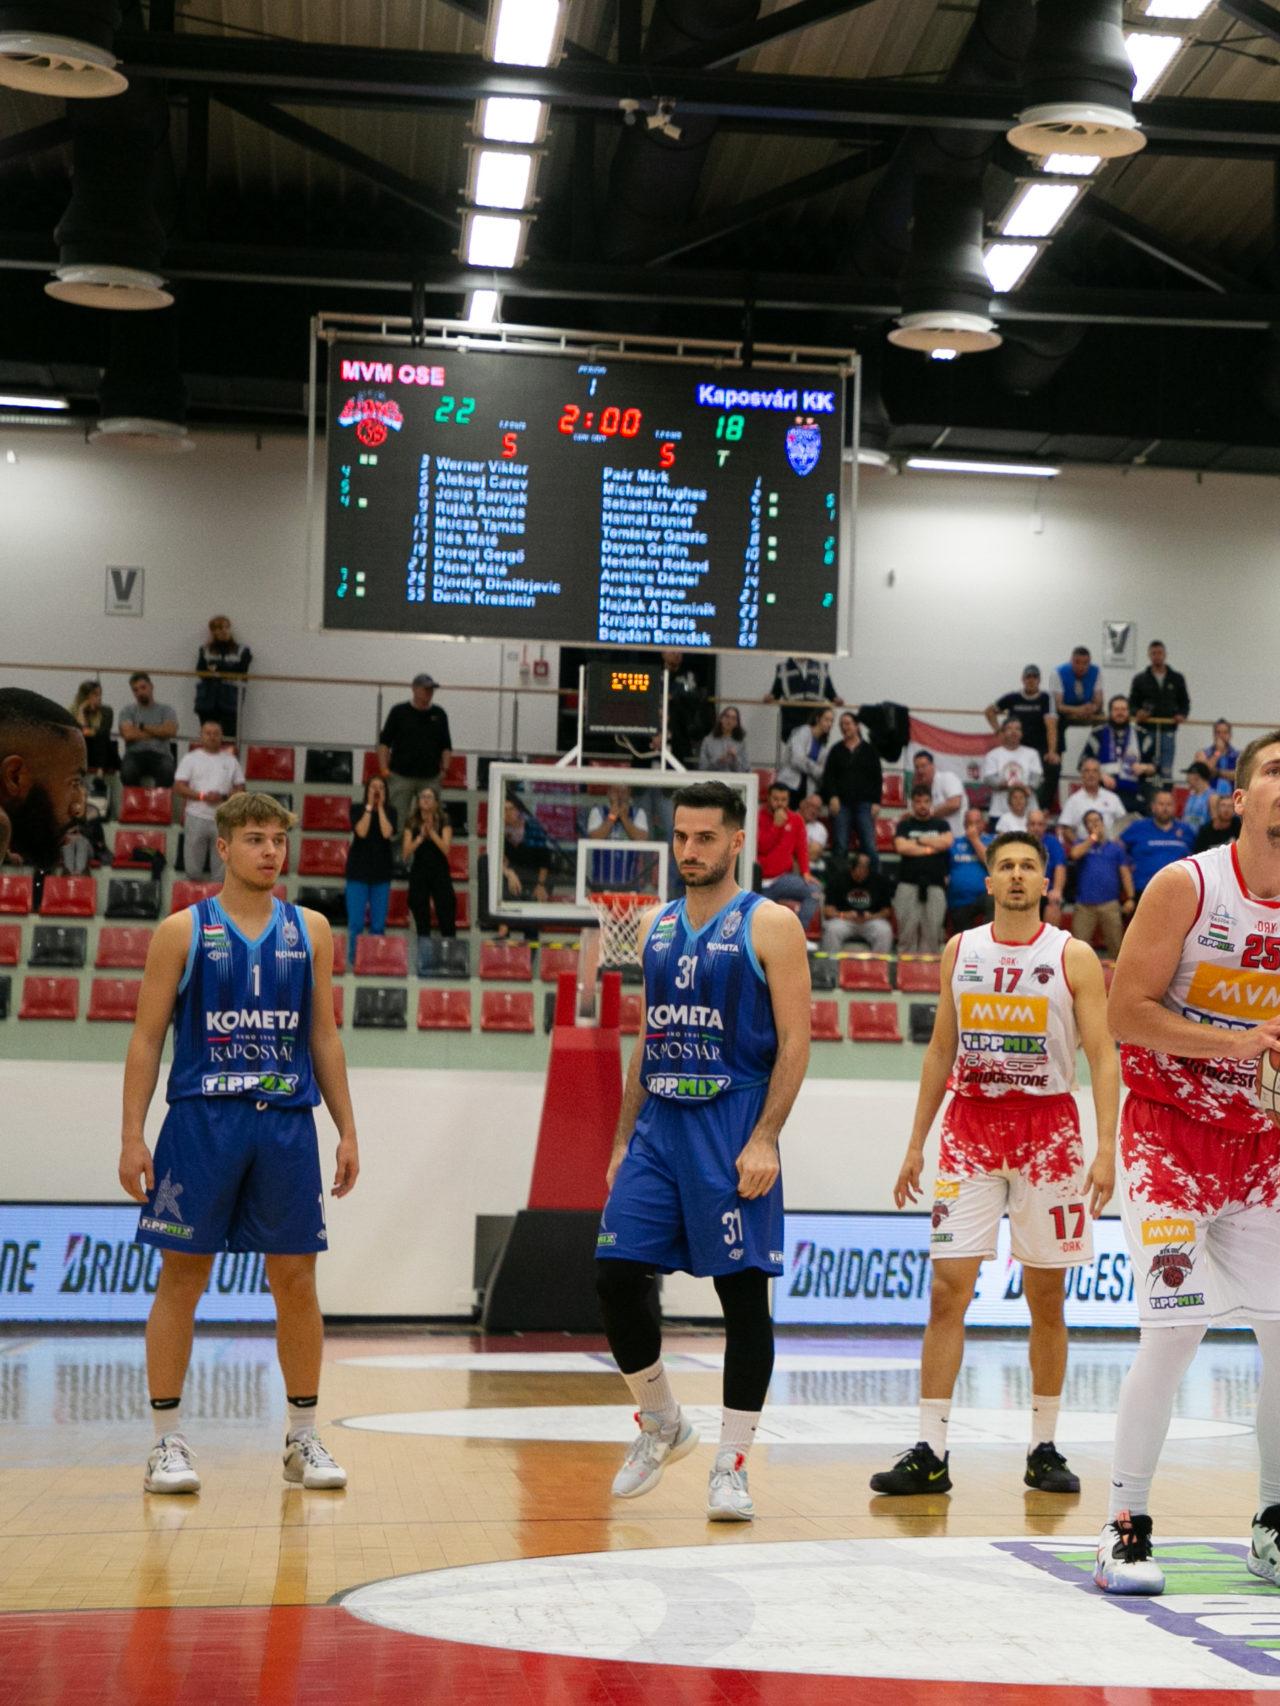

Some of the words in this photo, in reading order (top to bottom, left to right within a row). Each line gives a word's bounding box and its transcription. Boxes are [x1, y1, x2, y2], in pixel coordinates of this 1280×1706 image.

[341, 360, 393, 383] MVM
[398, 364, 445, 386] OSE
[435, 396, 475, 424] 22
[697, 384, 798, 410] Kaposvári
[802, 391, 835, 413] KK
[558, 404, 642, 438] 2:00
[716, 414, 745, 442] 18
[502, 432, 517, 458] 5
[659, 443, 675, 467] 5
[488, 460, 529, 475] Viktor
[717, 450, 730, 467] T
[111, 568, 137, 602] V
[252, 964, 260, 996] 1
[675, 955, 698, 989] 31
[993, 967, 1024, 993] 17
[206, 1008, 298, 1034] KOMETA
[970, 1002, 1035, 1024] MVM
[961, 1033, 1047, 1055] TiPPMIX
[964, 1070, 1049, 1087] BRIDGESTONE
[721, 1208, 743, 1245] 31
[1049, 1203, 1085, 1240] 17
[1148, 1225, 1190, 1238] MVM
[789, 1240, 931, 1298] BRIDGEST
[1149, 1292, 1205, 1309] TiPPMIX
